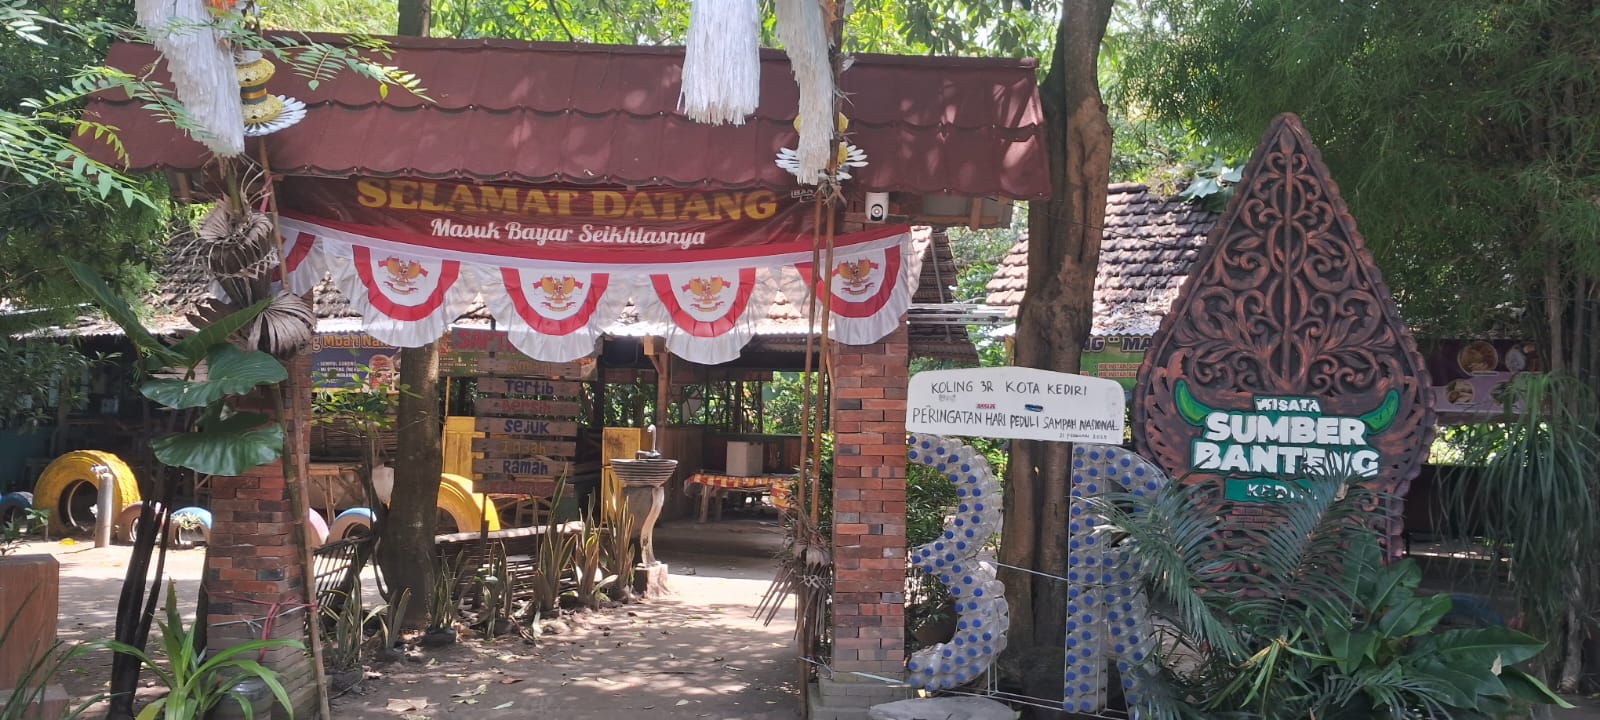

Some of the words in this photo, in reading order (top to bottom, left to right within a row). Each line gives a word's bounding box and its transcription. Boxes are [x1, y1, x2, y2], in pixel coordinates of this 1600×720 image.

[356, 178, 579, 216] SELAMAT
[591, 189, 777, 221] DATANG
[430, 218, 500, 239] Masuk
[505, 221, 573, 246] Bayar
[579, 224, 706, 249] Seikhlasnya
[456, 330, 517, 352] SAPT
[931, 381, 973, 394] KOLING
[980, 381, 994, 392] 3R
[1005, 381, 1040, 394] KOTA
[1047, 384, 1087, 396] KEDIRI
[1256, 398, 1321, 412] WISATA
[912, 408, 982, 424] PERINGATAN
[985, 412, 1006, 427] HARI
[1010, 414, 1039, 430] PEDULI
[1043, 416, 1077, 431] SAMPAH
[1079, 418, 1120, 432] NASIONAL
[1205, 412, 1367, 446] SUMBER
